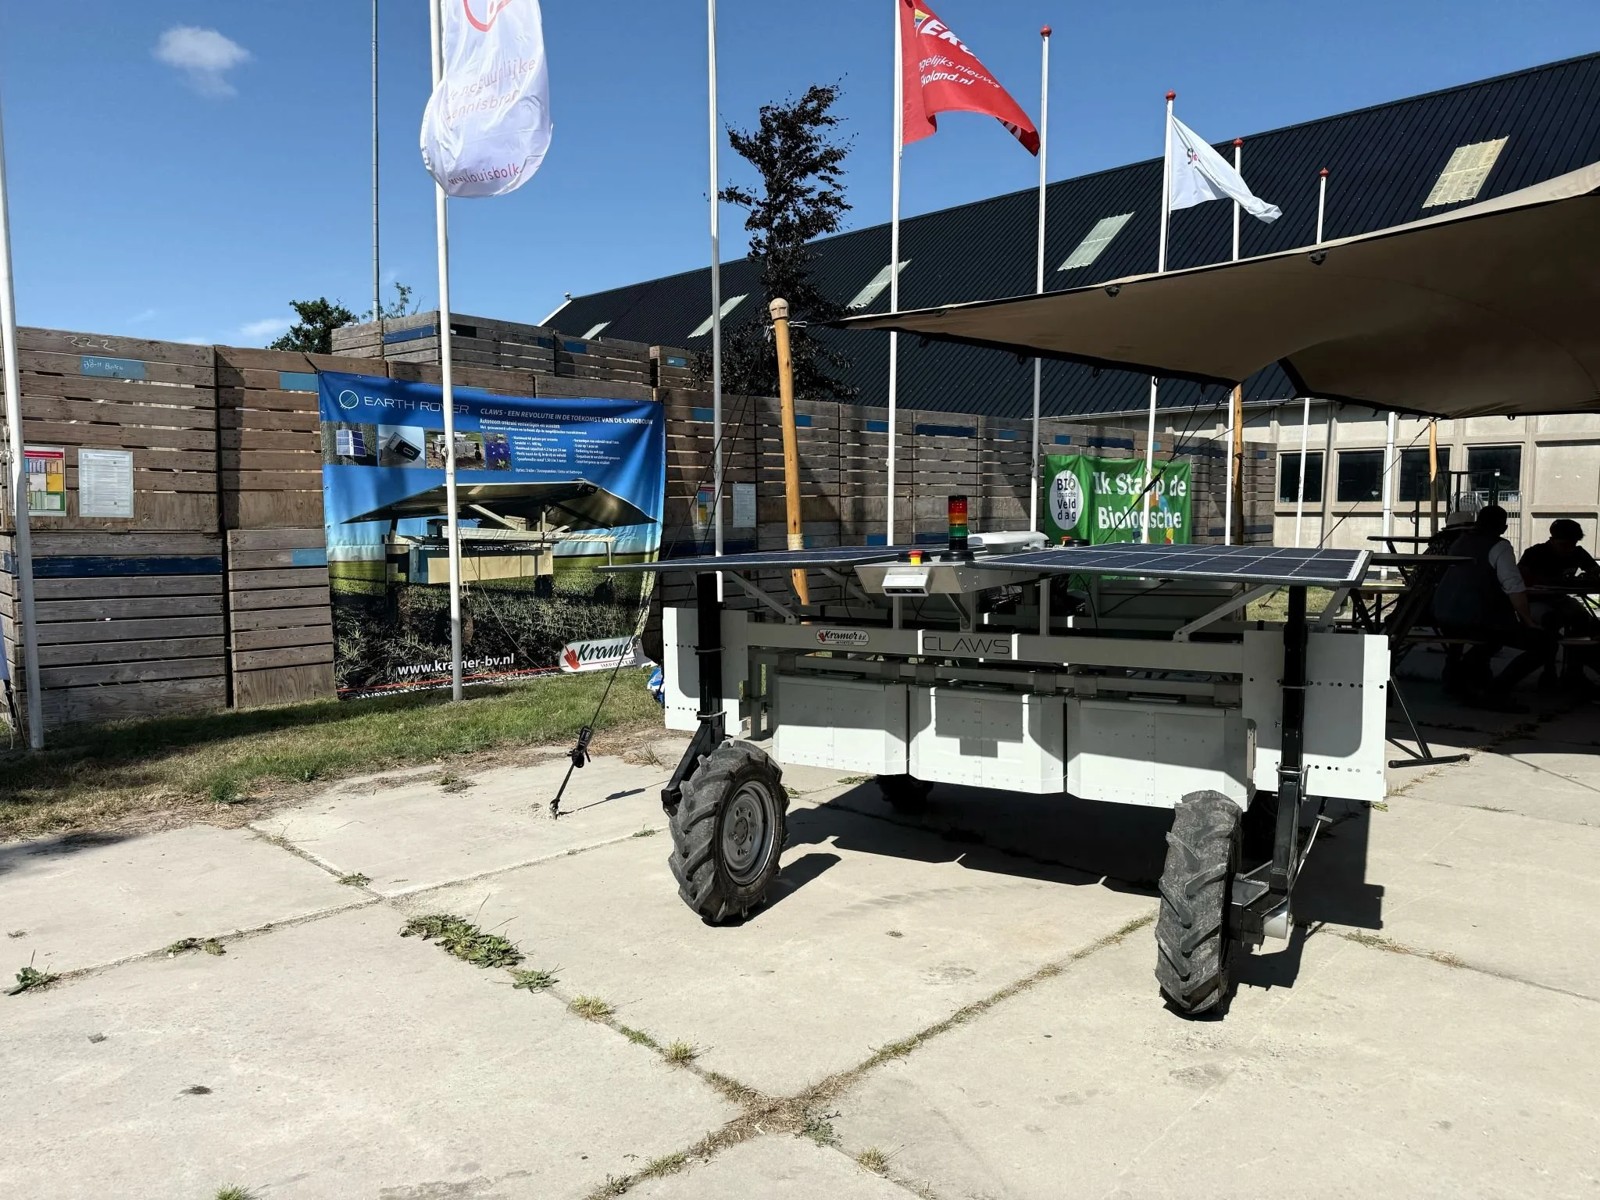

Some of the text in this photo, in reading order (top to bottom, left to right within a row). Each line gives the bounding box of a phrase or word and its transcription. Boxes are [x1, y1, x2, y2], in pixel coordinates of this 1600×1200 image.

[955, 65, 1000, 88] nieuws
[364, 396, 470, 414] EARTH ROER
[520, 411, 554, 419] REVOLUTIE
[571, 415, 600, 423] TOEKOMST
[1093, 471, 1112, 495] Ik
[1170, 475, 1187, 497] de
[1057, 499, 1076, 509] Veld
[825, 630, 858, 640] Kramer
[577, 640, 634, 661] Krame
[923, 636, 1009, 655] CLAWS
